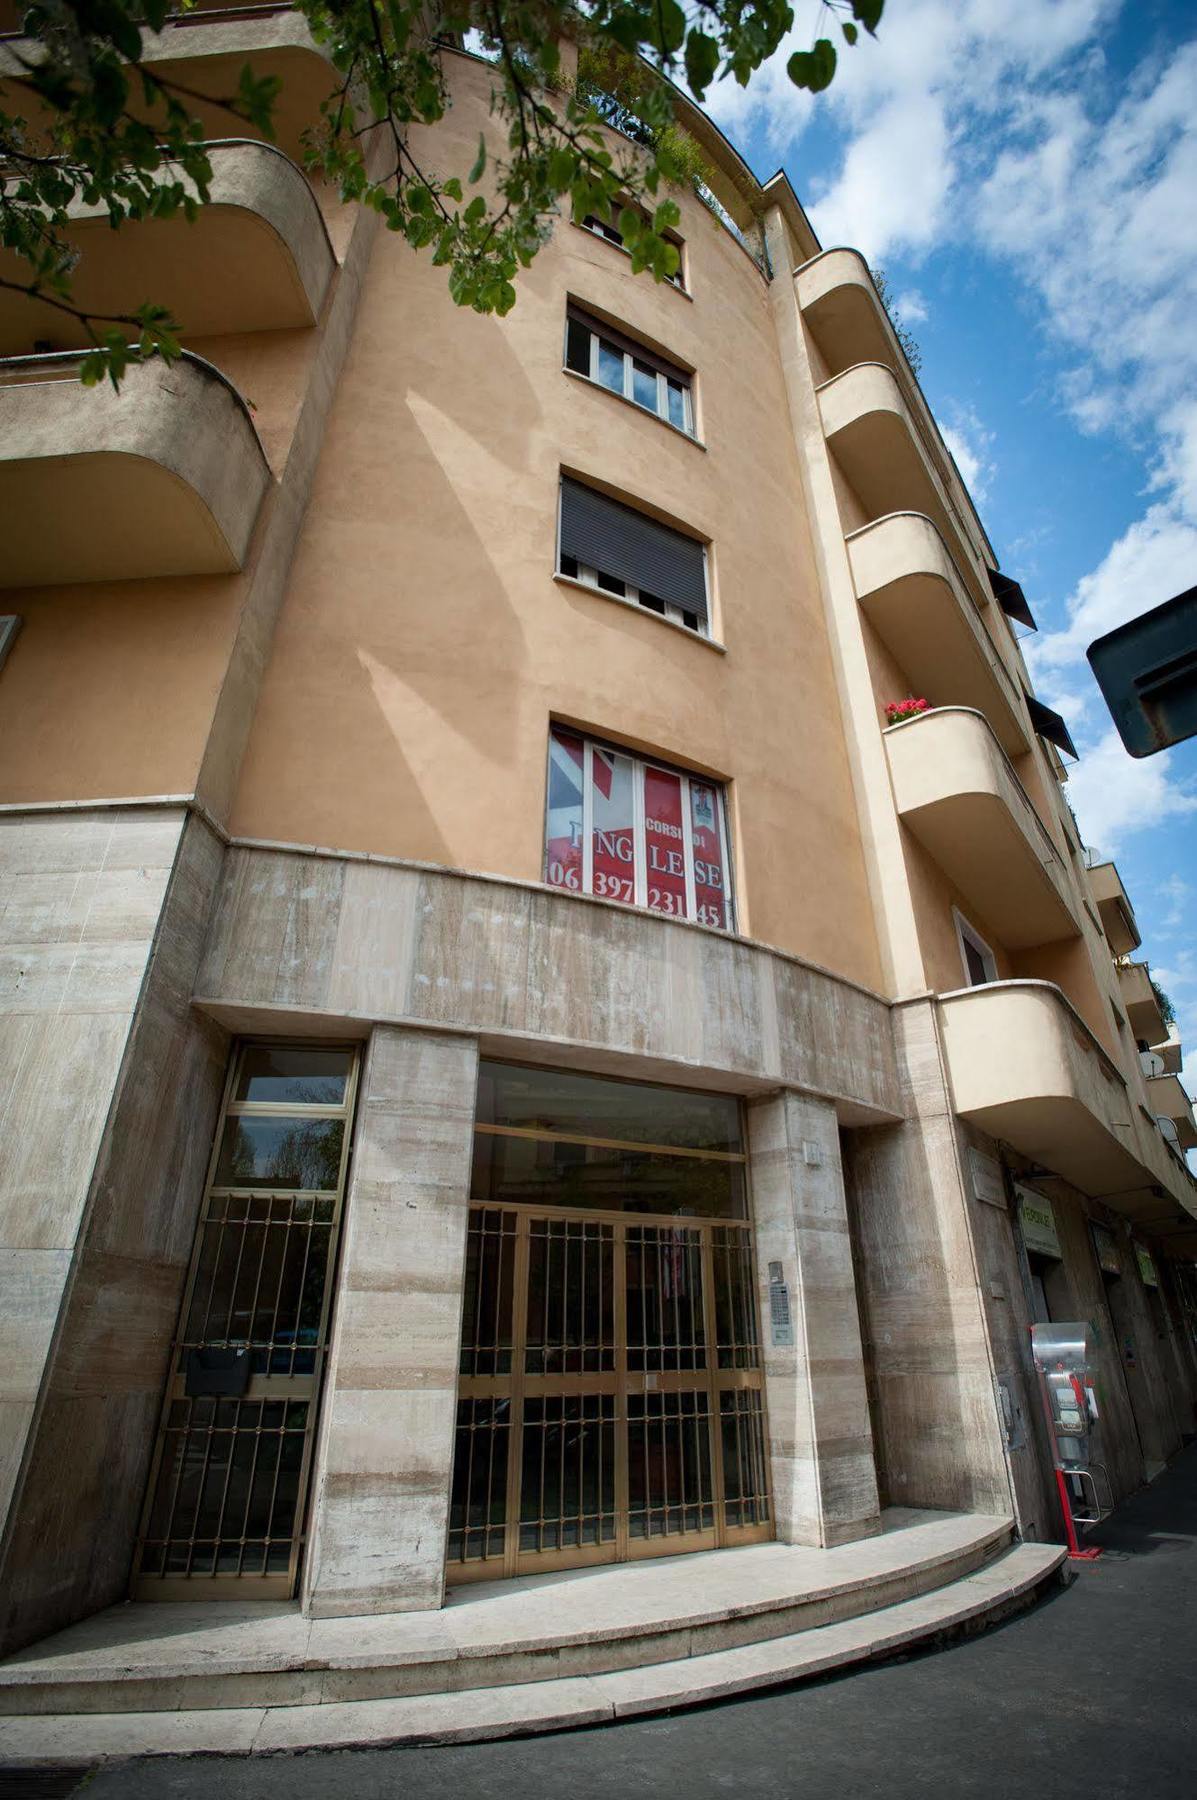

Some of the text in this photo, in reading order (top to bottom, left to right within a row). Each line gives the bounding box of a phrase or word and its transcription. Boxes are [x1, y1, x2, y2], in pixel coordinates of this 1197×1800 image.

[646, 817, 682, 840] CORSI
[550, 862, 720, 929] 06 397 231 45
